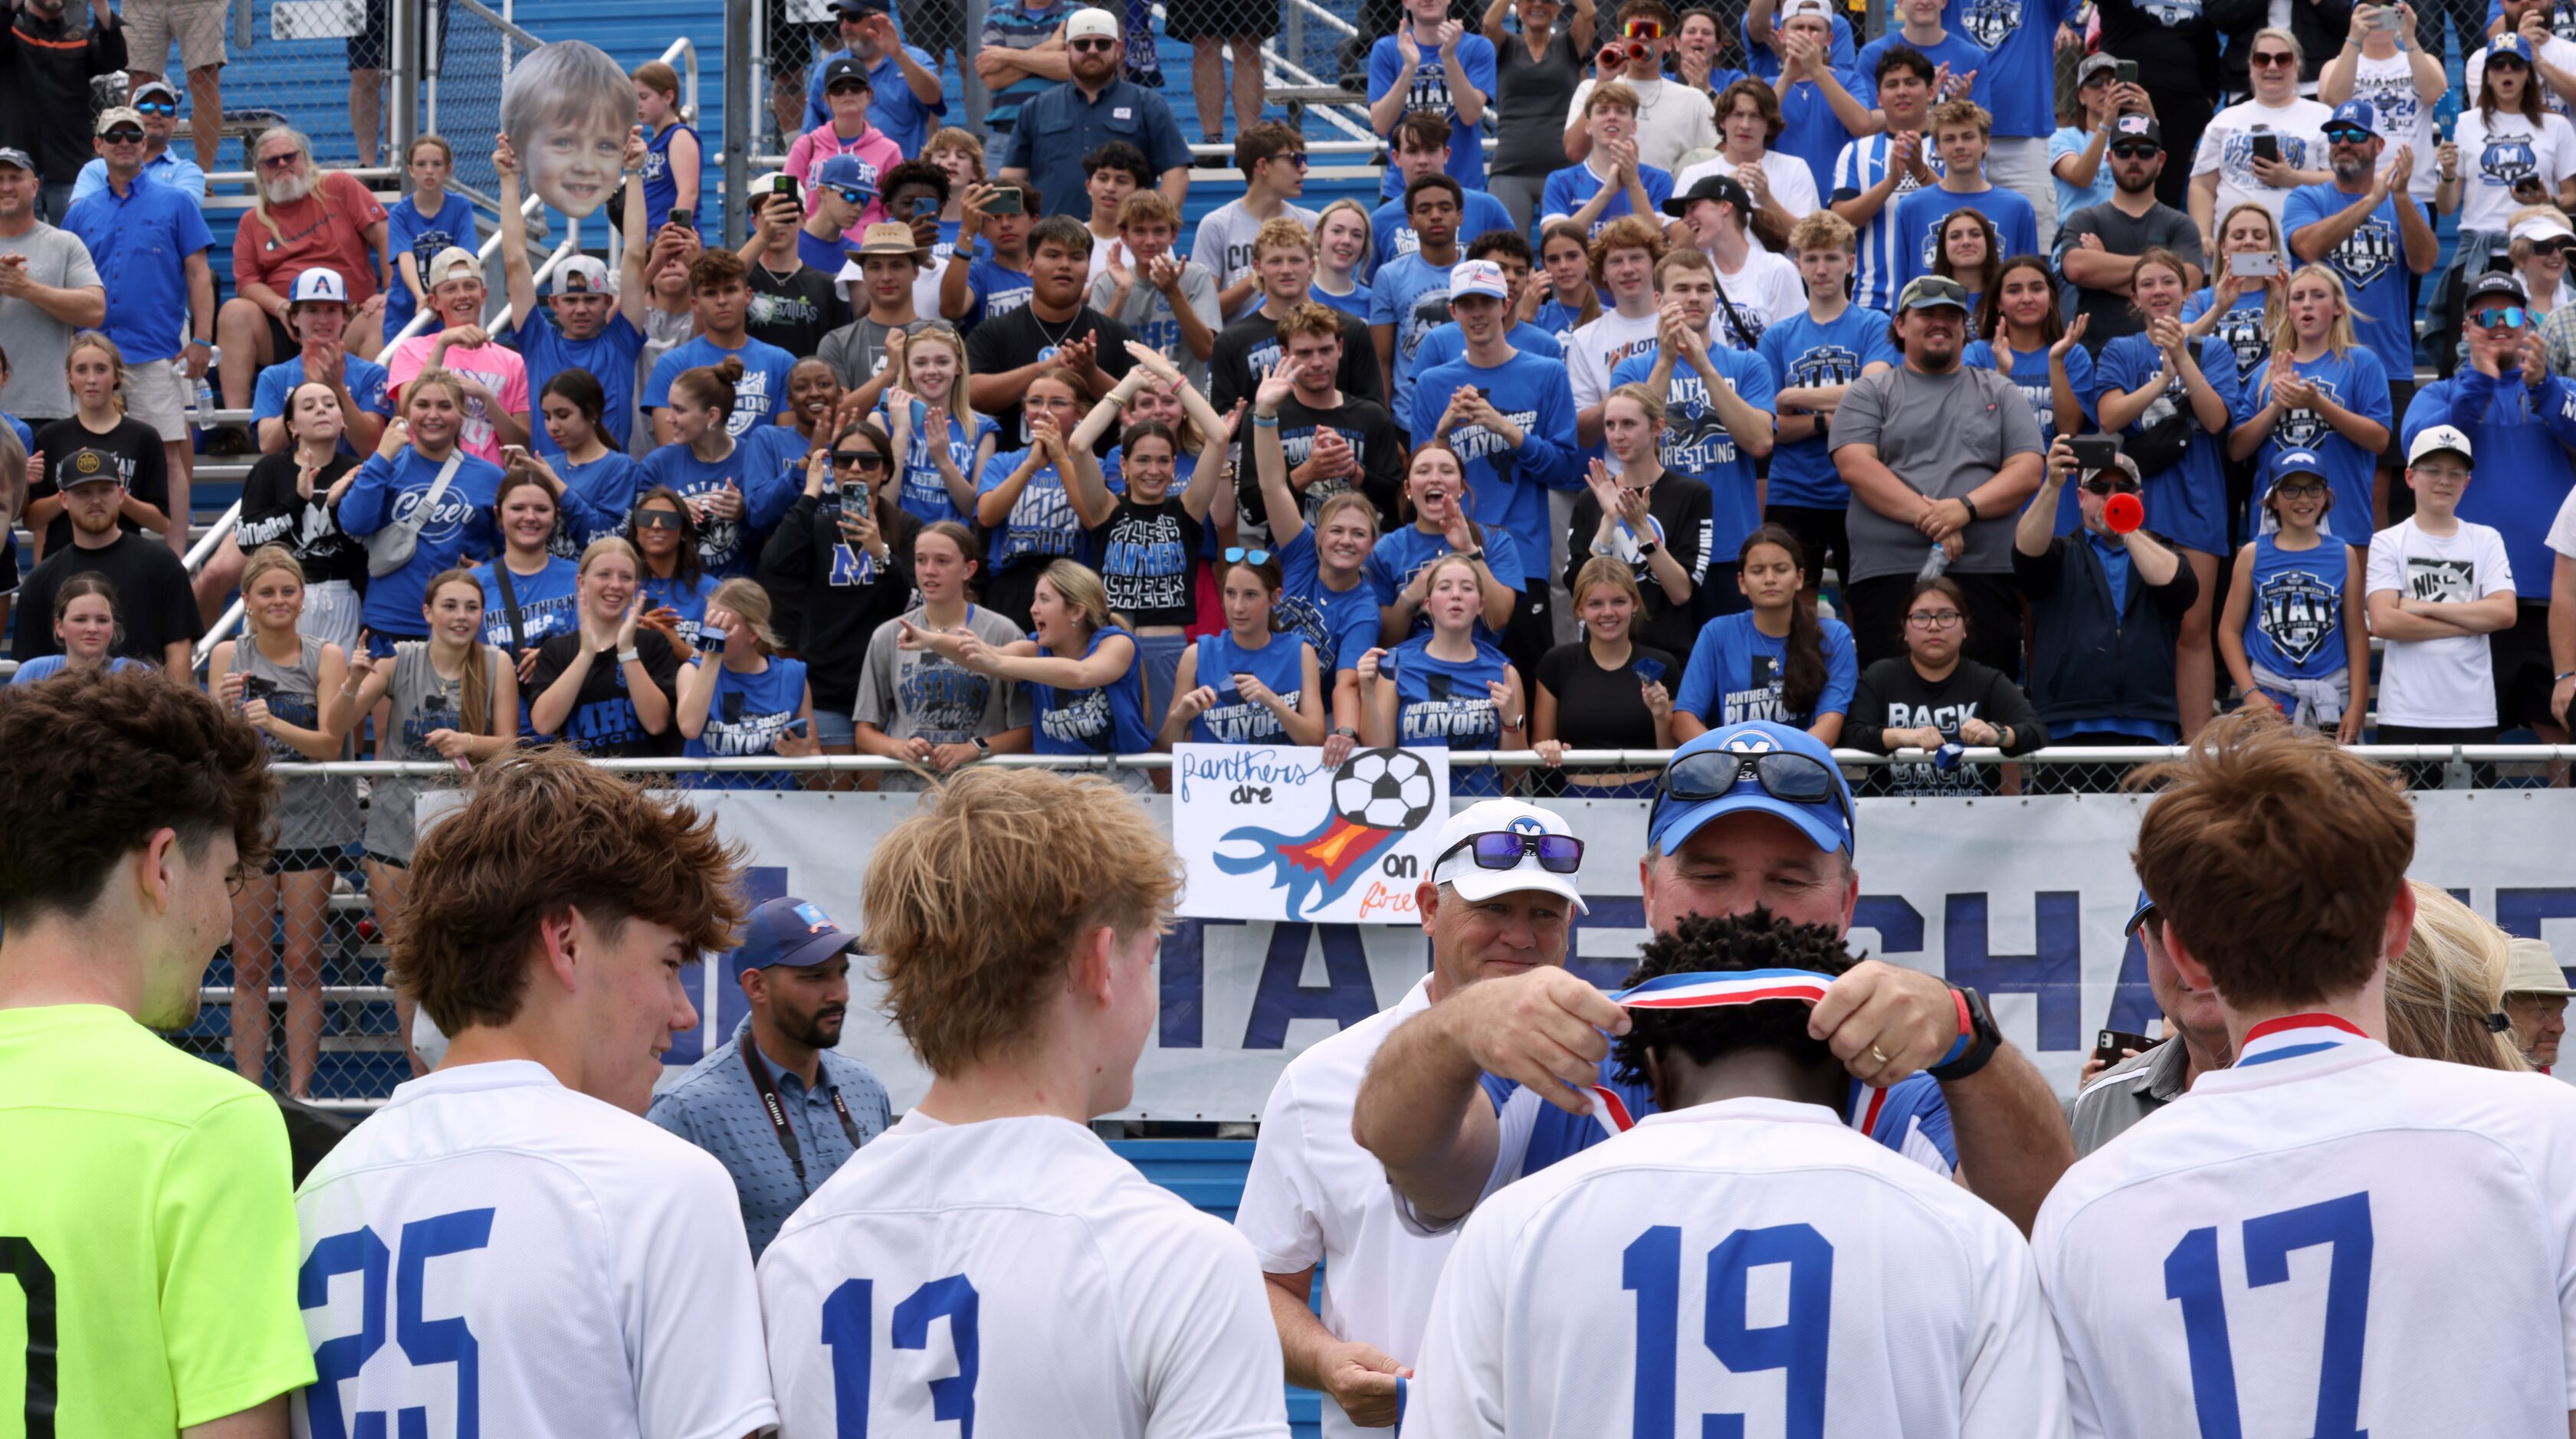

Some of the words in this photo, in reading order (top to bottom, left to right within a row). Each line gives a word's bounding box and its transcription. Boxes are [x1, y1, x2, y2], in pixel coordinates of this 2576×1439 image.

[2397, 99, 2416, 116] 24
[2498, 147, 2519, 162] M
[313, 276, 332, 293] A
[745, 395, 772, 411] DAY
[1504, 411, 1537, 424] OCCER
[1660, 441, 1736, 467] RESTLING
[392, 491, 477, 527] Ceer
[706, 552, 731, 567] HIGH
[829, 543, 875, 586] M
[1102, 539, 1187, 577] PANTHERS
[899, 669, 990, 715] DISTRICT
[1726, 687, 1770, 705] PANTHER
[1203, 704, 1247, 720] PANTHER
[1405, 701, 1448, 716] PANTHER
[1889, 702, 1977, 733] BACK
[1403, 710, 1495, 739] PLAYOFFS
[1229, 785, 1273, 805] are
[1383, 854, 1418, 879] on
[764, 1093, 785, 1126] Canon
[298, 1207, 496, 1439] 25
[2164, 1189, 2374, 1439] 17
[1622, 1222, 1834, 1439] 19
[821, 1272, 980, 1439] 13
